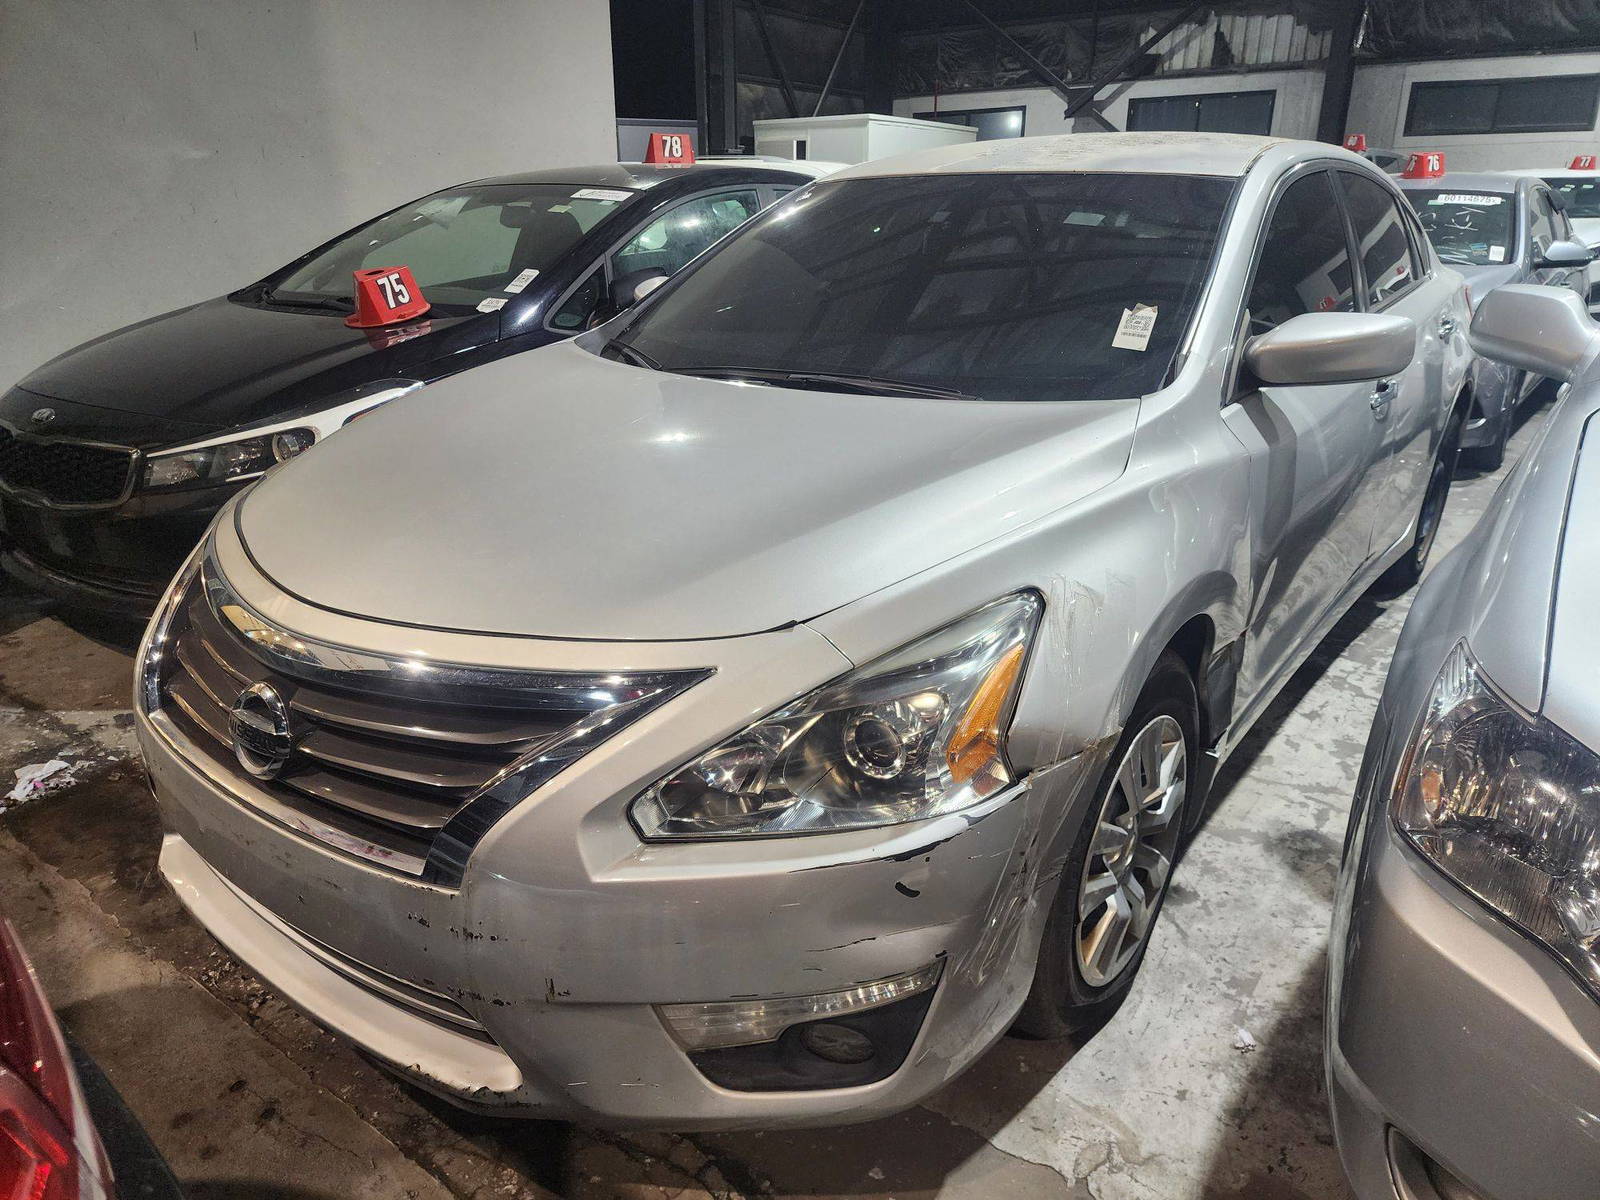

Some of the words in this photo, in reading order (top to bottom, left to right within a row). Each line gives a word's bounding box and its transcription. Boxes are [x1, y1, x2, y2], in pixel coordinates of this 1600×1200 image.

[662, 136, 682, 158] 78
[1427, 154, 1440, 172] 76
[1580, 156, 1592, 168] 77
[376, 273, 410, 309] 75
